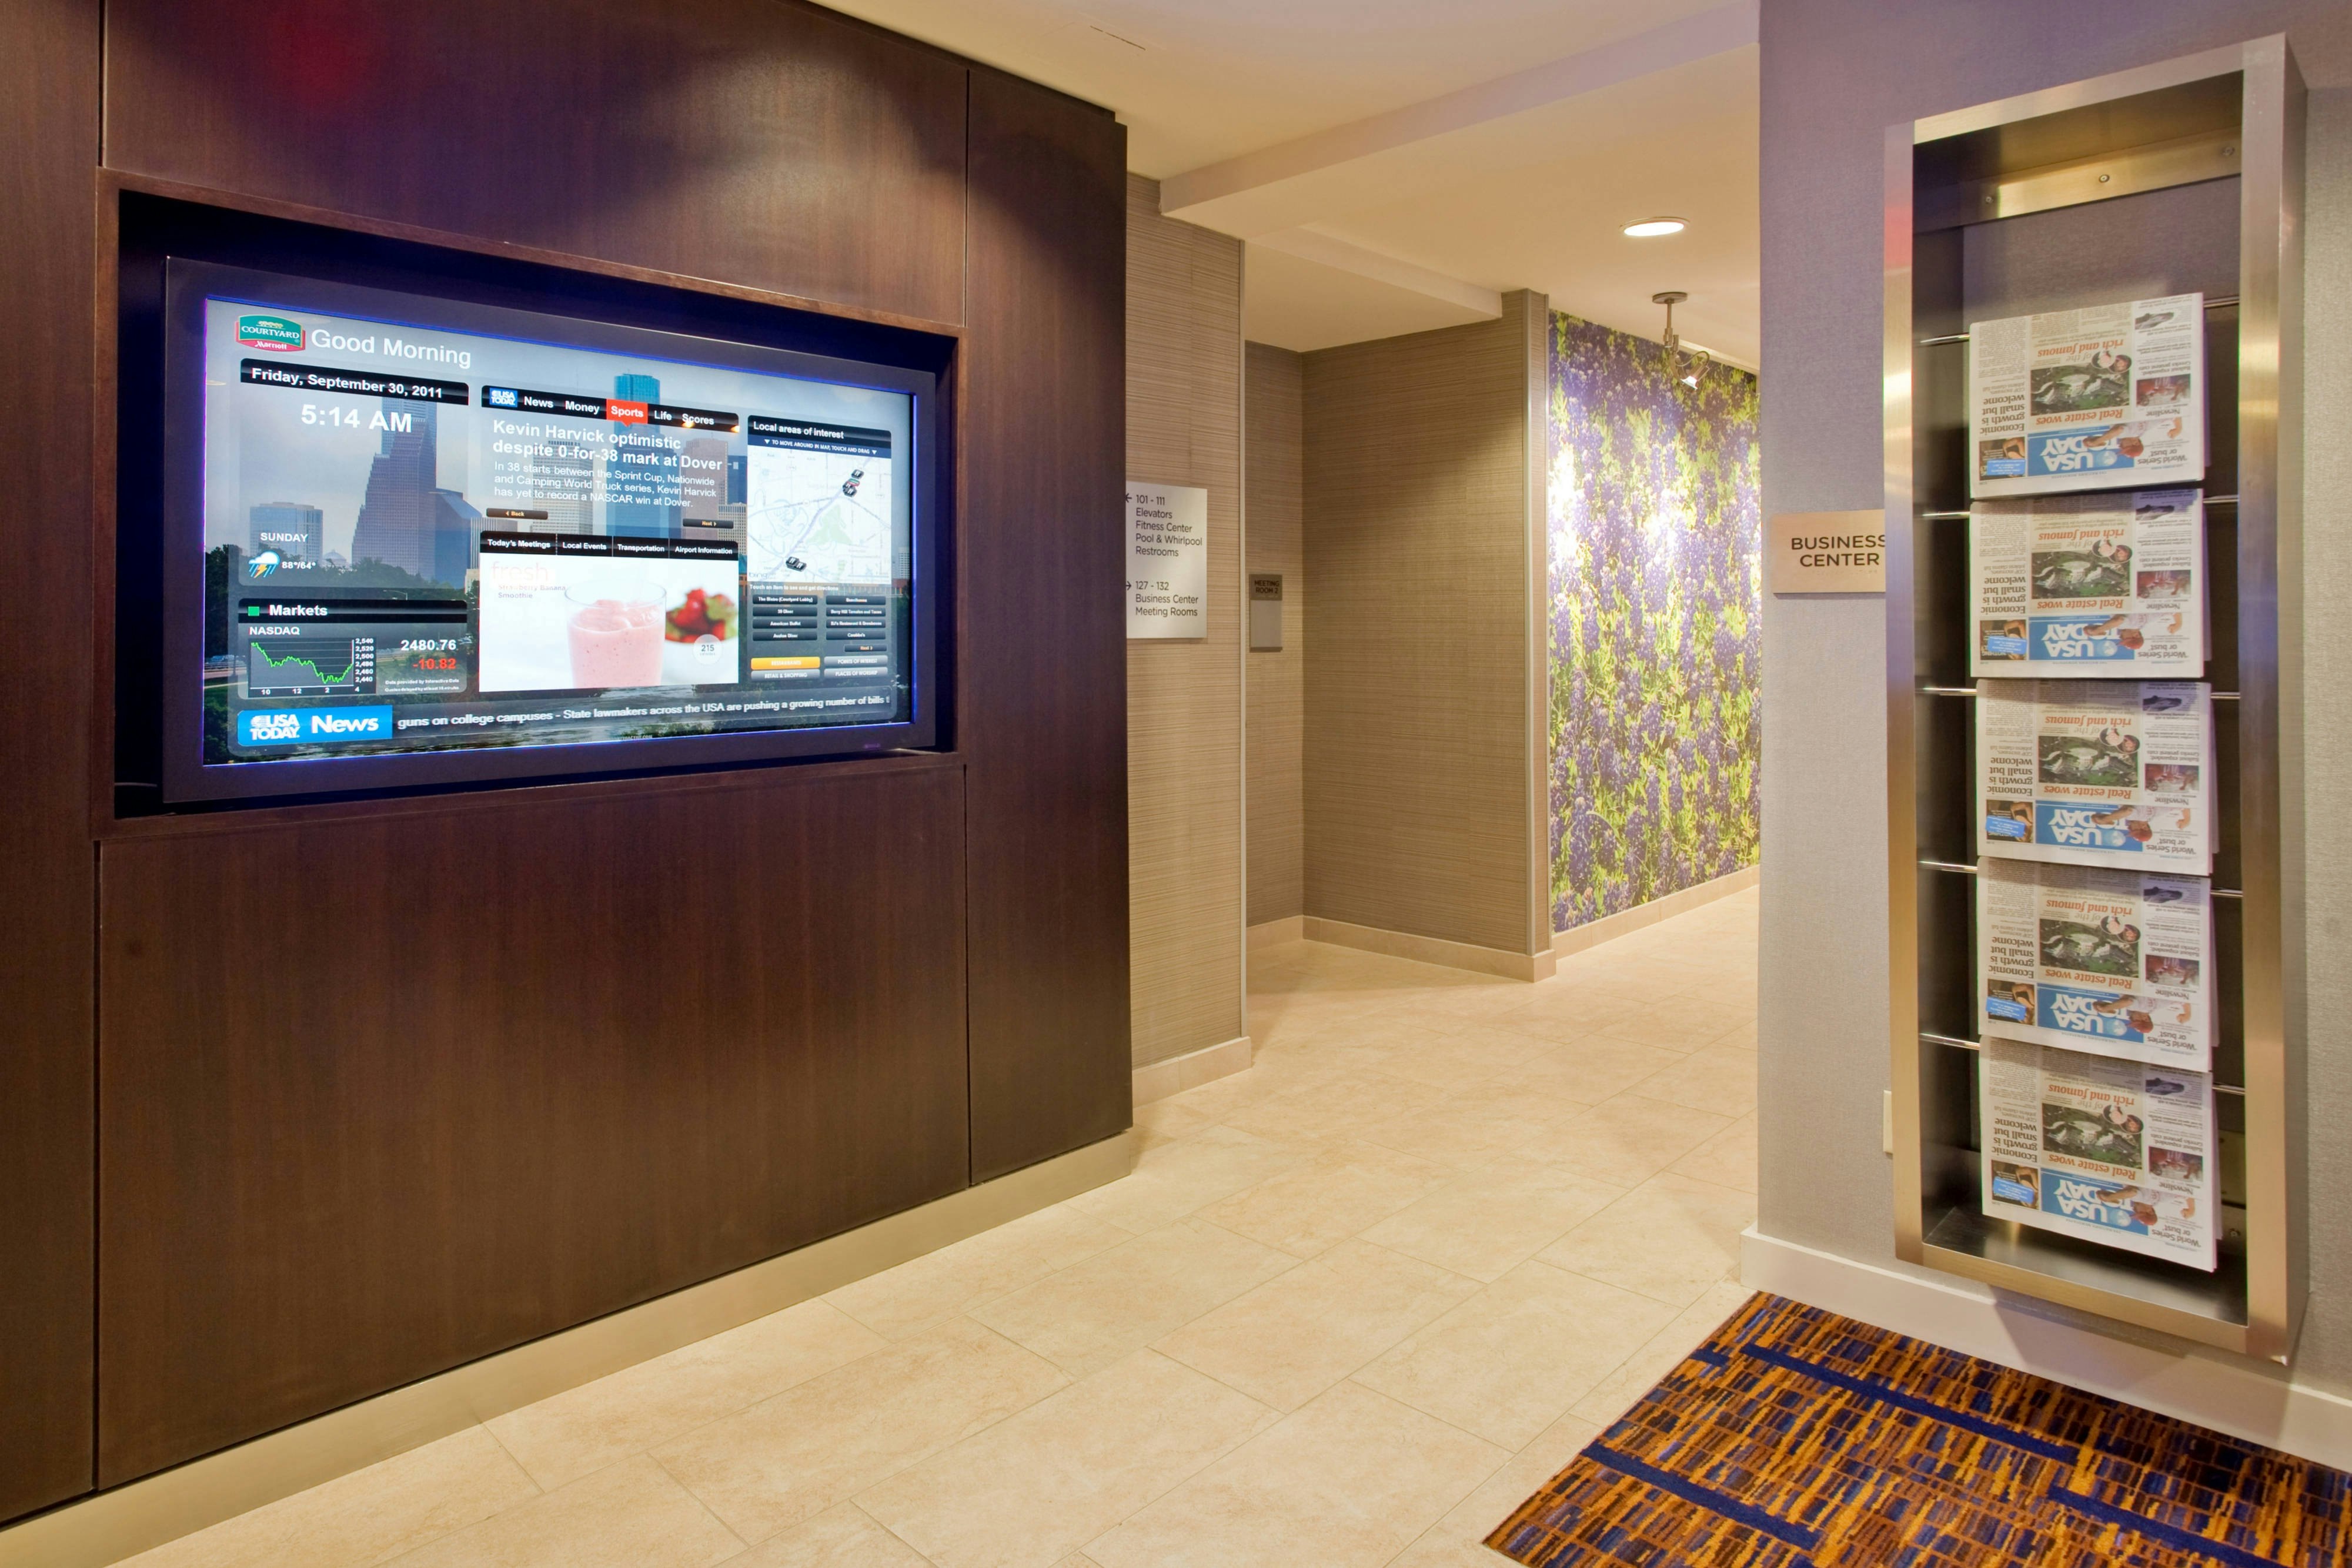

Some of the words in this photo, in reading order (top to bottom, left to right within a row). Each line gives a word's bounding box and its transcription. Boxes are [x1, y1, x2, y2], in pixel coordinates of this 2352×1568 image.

[242, 326, 299, 340] COURTYARD
[255, 340, 287, 350] Marriott
[311, 329, 374, 353] Good
[385, 339, 470, 369] Morning
[252, 368, 303, 385] Friday,
[308, 375, 385, 394] September
[388, 383, 408, 396] 30,
[412, 386, 442, 397] 2011
[524, 396, 553, 408] News
[566, 401, 599, 414] Money
[611, 406, 643, 419] Sports
[654, 410, 671, 421] Life
[2065, 412, 2096, 423] estate
[2099, 409, 2123, 422] Real
[302, 404, 359, 428] 5:14
[369, 411, 412, 433] AM
[682, 413, 714, 424] Scores
[2036, 416, 2062, 426] woes
[493, 420, 540, 437] Kevin
[546, 425, 604, 442] Harvick
[609, 432, 681, 449] optimistic
[754, 421, 776, 431] Local
[779, 426, 801, 434] areas
[814, 429, 844, 439] interest
[493, 439, 553, 458] despite
[559, 446, 617, 462] 0-for-38
[623, 452, 659, 466] mark
[664, 455, 677, 467] at
[681, 456, 721, 470] Dover
[2043, 453, 2094, 472] USA
[495, 462, 504, 470] In
[507, 462, 519, 471] 38
[523, 464, 550, 473] starts
[554, 466, 594, 476] between
[597, 468, 612, 477] the
[615, 470, 642, 482] Sprint
[667, 474, 714, 485] Nationwide
[495, 474, 513, 483] and
[517, 475, 561, 489] Camping
[564, 479, 592, 489] World
[596, 481, 621, 491] Truck
[657, 484, 681, 494] Kevin
[684, 487, 716, 497] Harvick
[495, 487, 512, 496] has
[516, 490, 532, 499] yet
[535, 490, 543, 498] to
[547, 490, 578, 500] record
[590, 492, 633, 503] NASCAR
[636, 496, 650, 504] win
[1136, 495, 1148, 503] 101
[1156, 496, 1165, 505] 111
[1137, 508, 1172, 519] Elevators
[1136, 521, 1164, 530] Fitness
[1167, 523, 1192, 532] Center
[260, 533, 308, 542] SUNDAY
[2039, 530, 2078, 541] famous
[2080, 530, 2100, 540] and
[2103, 529, 2124, 539] rich
[518, 540, 550, 549] Meetings
[1136, 534, 1154, 542] Pool
[1156, 535, 1162, 543] &
[1164, 536, 1202, 546] Whirlpool
[1792, 535, 1885, 550] BUSINESS
[675, 546, 696, 554] Airport
[1136, 546, 1178, 556] Restrooms
[1800, 553, 1879, 567] CENTER
[1157, 582, 1169, 590] 132
[1984, 577, 2026, 585] welcome
[2002, 587, 2026, 595] small
[1136, 594, 1170, 603] Business
[1173, 595, 1198, 604] Center
[1992, 594, 2026, 604] growth
[2099, 599, 2123, 609] Real
[269, 604, 328, 616] Markets
[1981, 606, 2026, 614] Economic
[2037, 601, 2062, 610] woes
[2066, 601, 2096, 610] estate
[1136, 607, 1168, 617] Meeting
[1171, 608, 1197, 616] Rooms
[249, 627, 300, 636] NASDAQ
[400, 640, 456, 651] 2480.76
[2043, 641, 2094, 657] USA
[397, 718, 429, 730] guns
[432, 717, 447, 726] on
[451, 714, 493, 727] college
[496, 711, 552, 726] campuses
[563, 709, 591, 720] State
[593, 707, 647, 718] lawmakers
[650, 706, 681, 715] across
[684, 705, 700, 713] the
[703, 703, 724, 712] USA
[743, 700, 780, 712] pushing
[789, 699, 823, 709] growing
[826, 696, 856, 706] number
[858, 696, 866, 704] of
[868, 696, 884, 704] bills
[268, 714, 300, 727] USA
[312, 715, 378, 733] News
[2044, 785, 2070, 795] woes
[2073, 787, 2105, 798] estate
[2108, 789, 2132, 800] Real
[2051, 826, 2102, 845] USA
[2053, 1011, 2103, 1033] USA
[2056, 1198, 2107, 1223] USA
